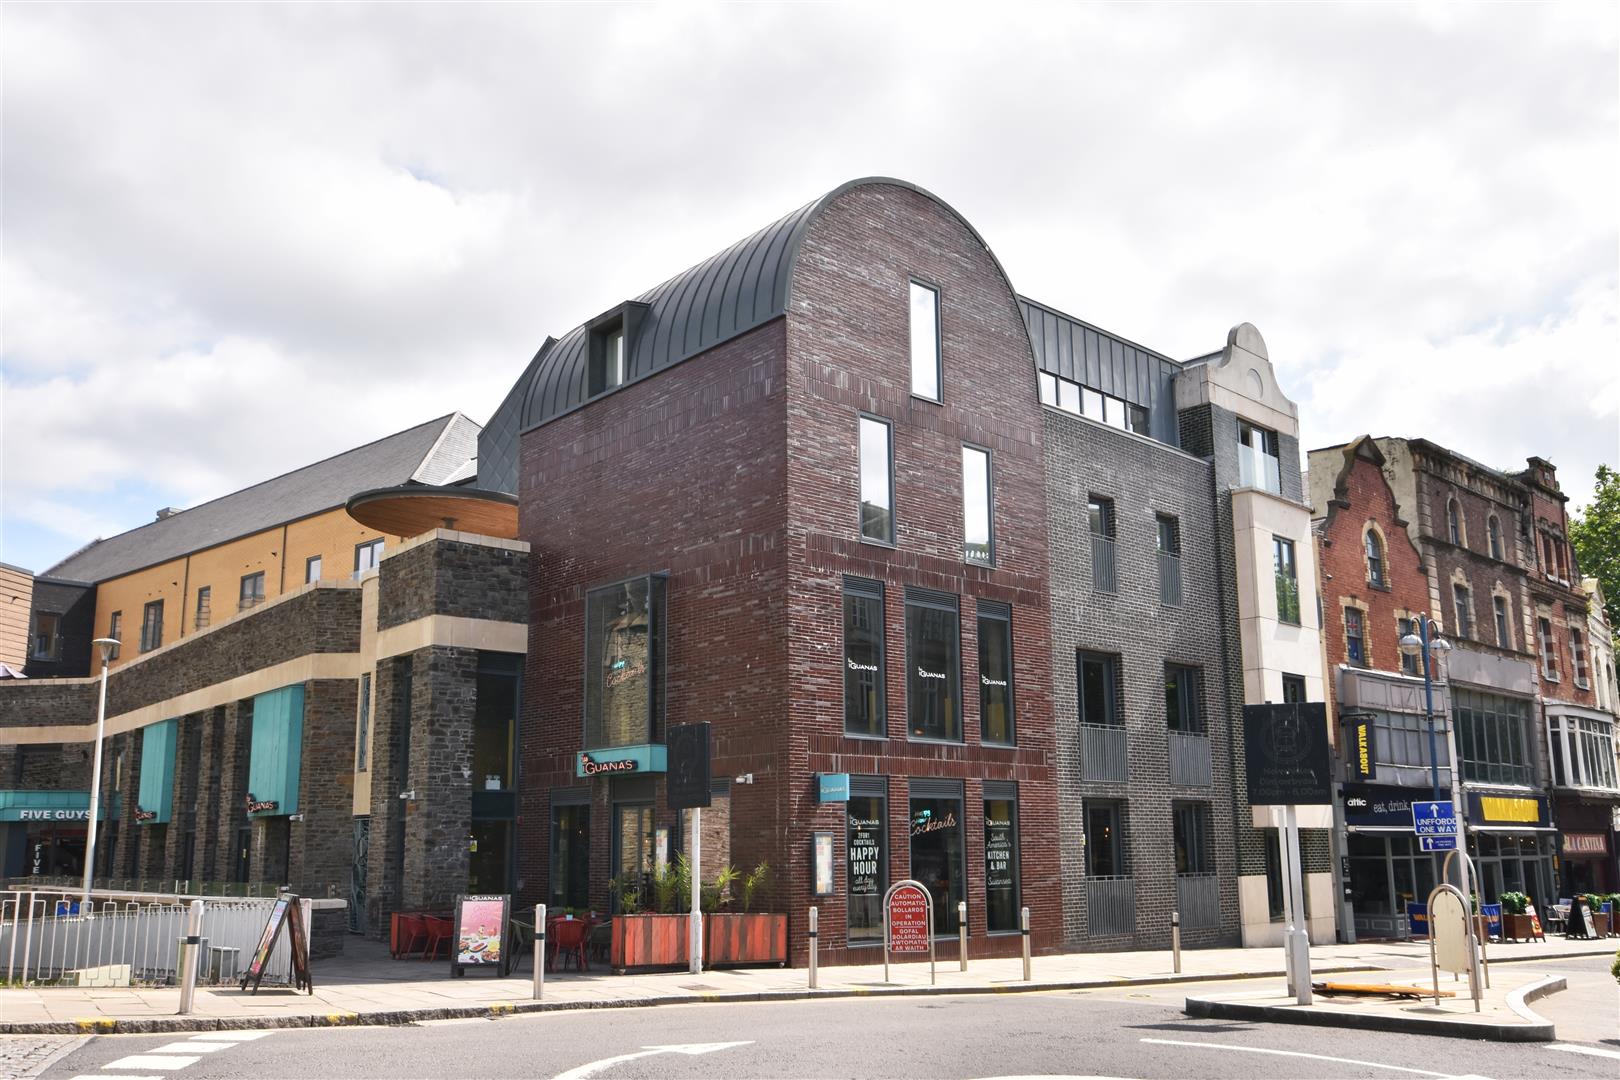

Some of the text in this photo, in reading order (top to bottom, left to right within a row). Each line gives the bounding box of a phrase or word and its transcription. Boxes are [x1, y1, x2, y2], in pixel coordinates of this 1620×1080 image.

[848, 662, 878, 671] IGUANAS
[918, 670, 946, 679] IGUANAS
[1358, 724, 1368, 774] WALKABOUT
[582, 760, 632, 774] IGUANAS
[1348, 798, 1366, 806] attic
[20, 810, 91, 819] FIVE GUYS
[910, 813, 956, 836] Cocktails
[32, 844, 42, 874] FIVE
[850, 846, 879, 860] HAPPY
[988, 850, 1010, 860] KITCHEN
[854, 861, 877, 875] HOUR
[990, 862, 1006, 870] & BAR
